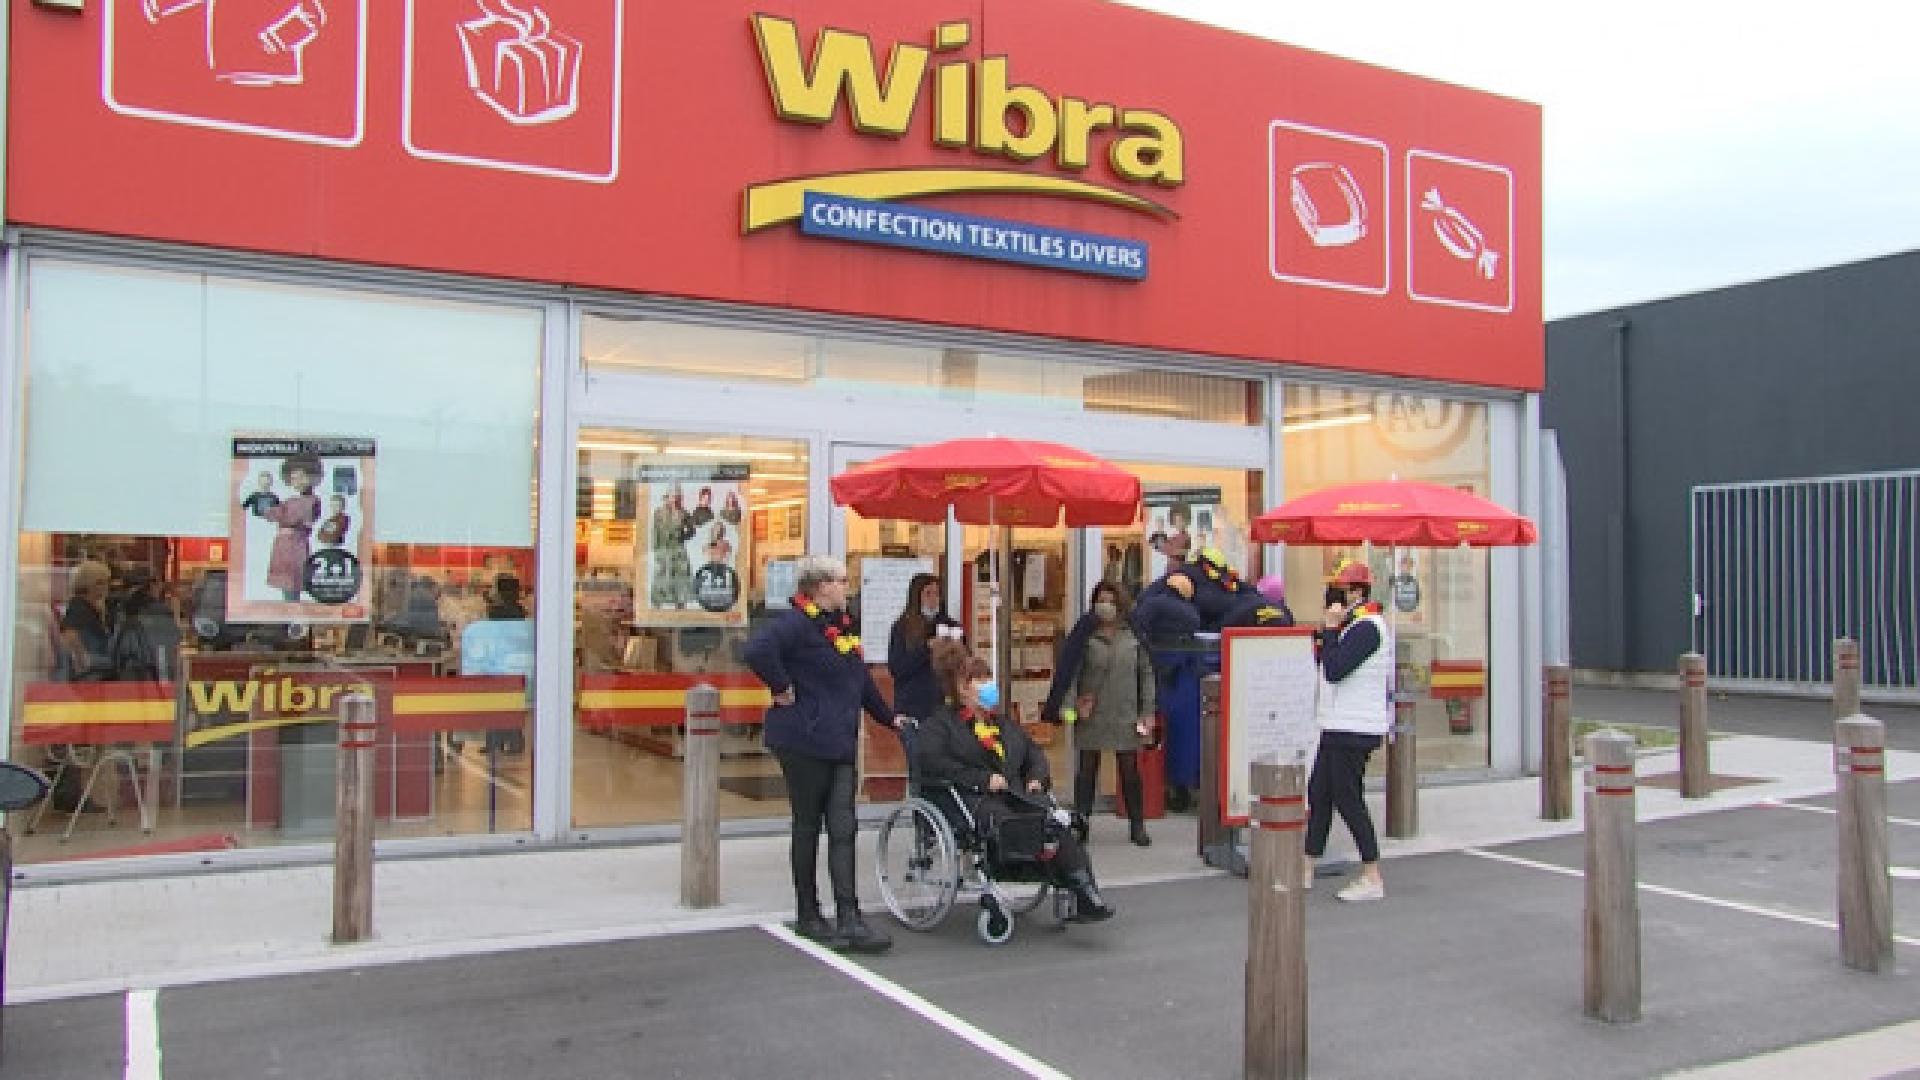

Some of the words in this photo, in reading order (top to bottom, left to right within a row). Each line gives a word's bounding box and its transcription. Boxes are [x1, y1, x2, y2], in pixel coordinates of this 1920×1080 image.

[751, 13, 1186, 187] Wibra
[811, 202, 964, 245] CONFECTION
[968, 223, 1065, 259] TEXTILES
[1069, 239, 1143, 271] DIVERS
[311, 557, 352, 580] 2+1
